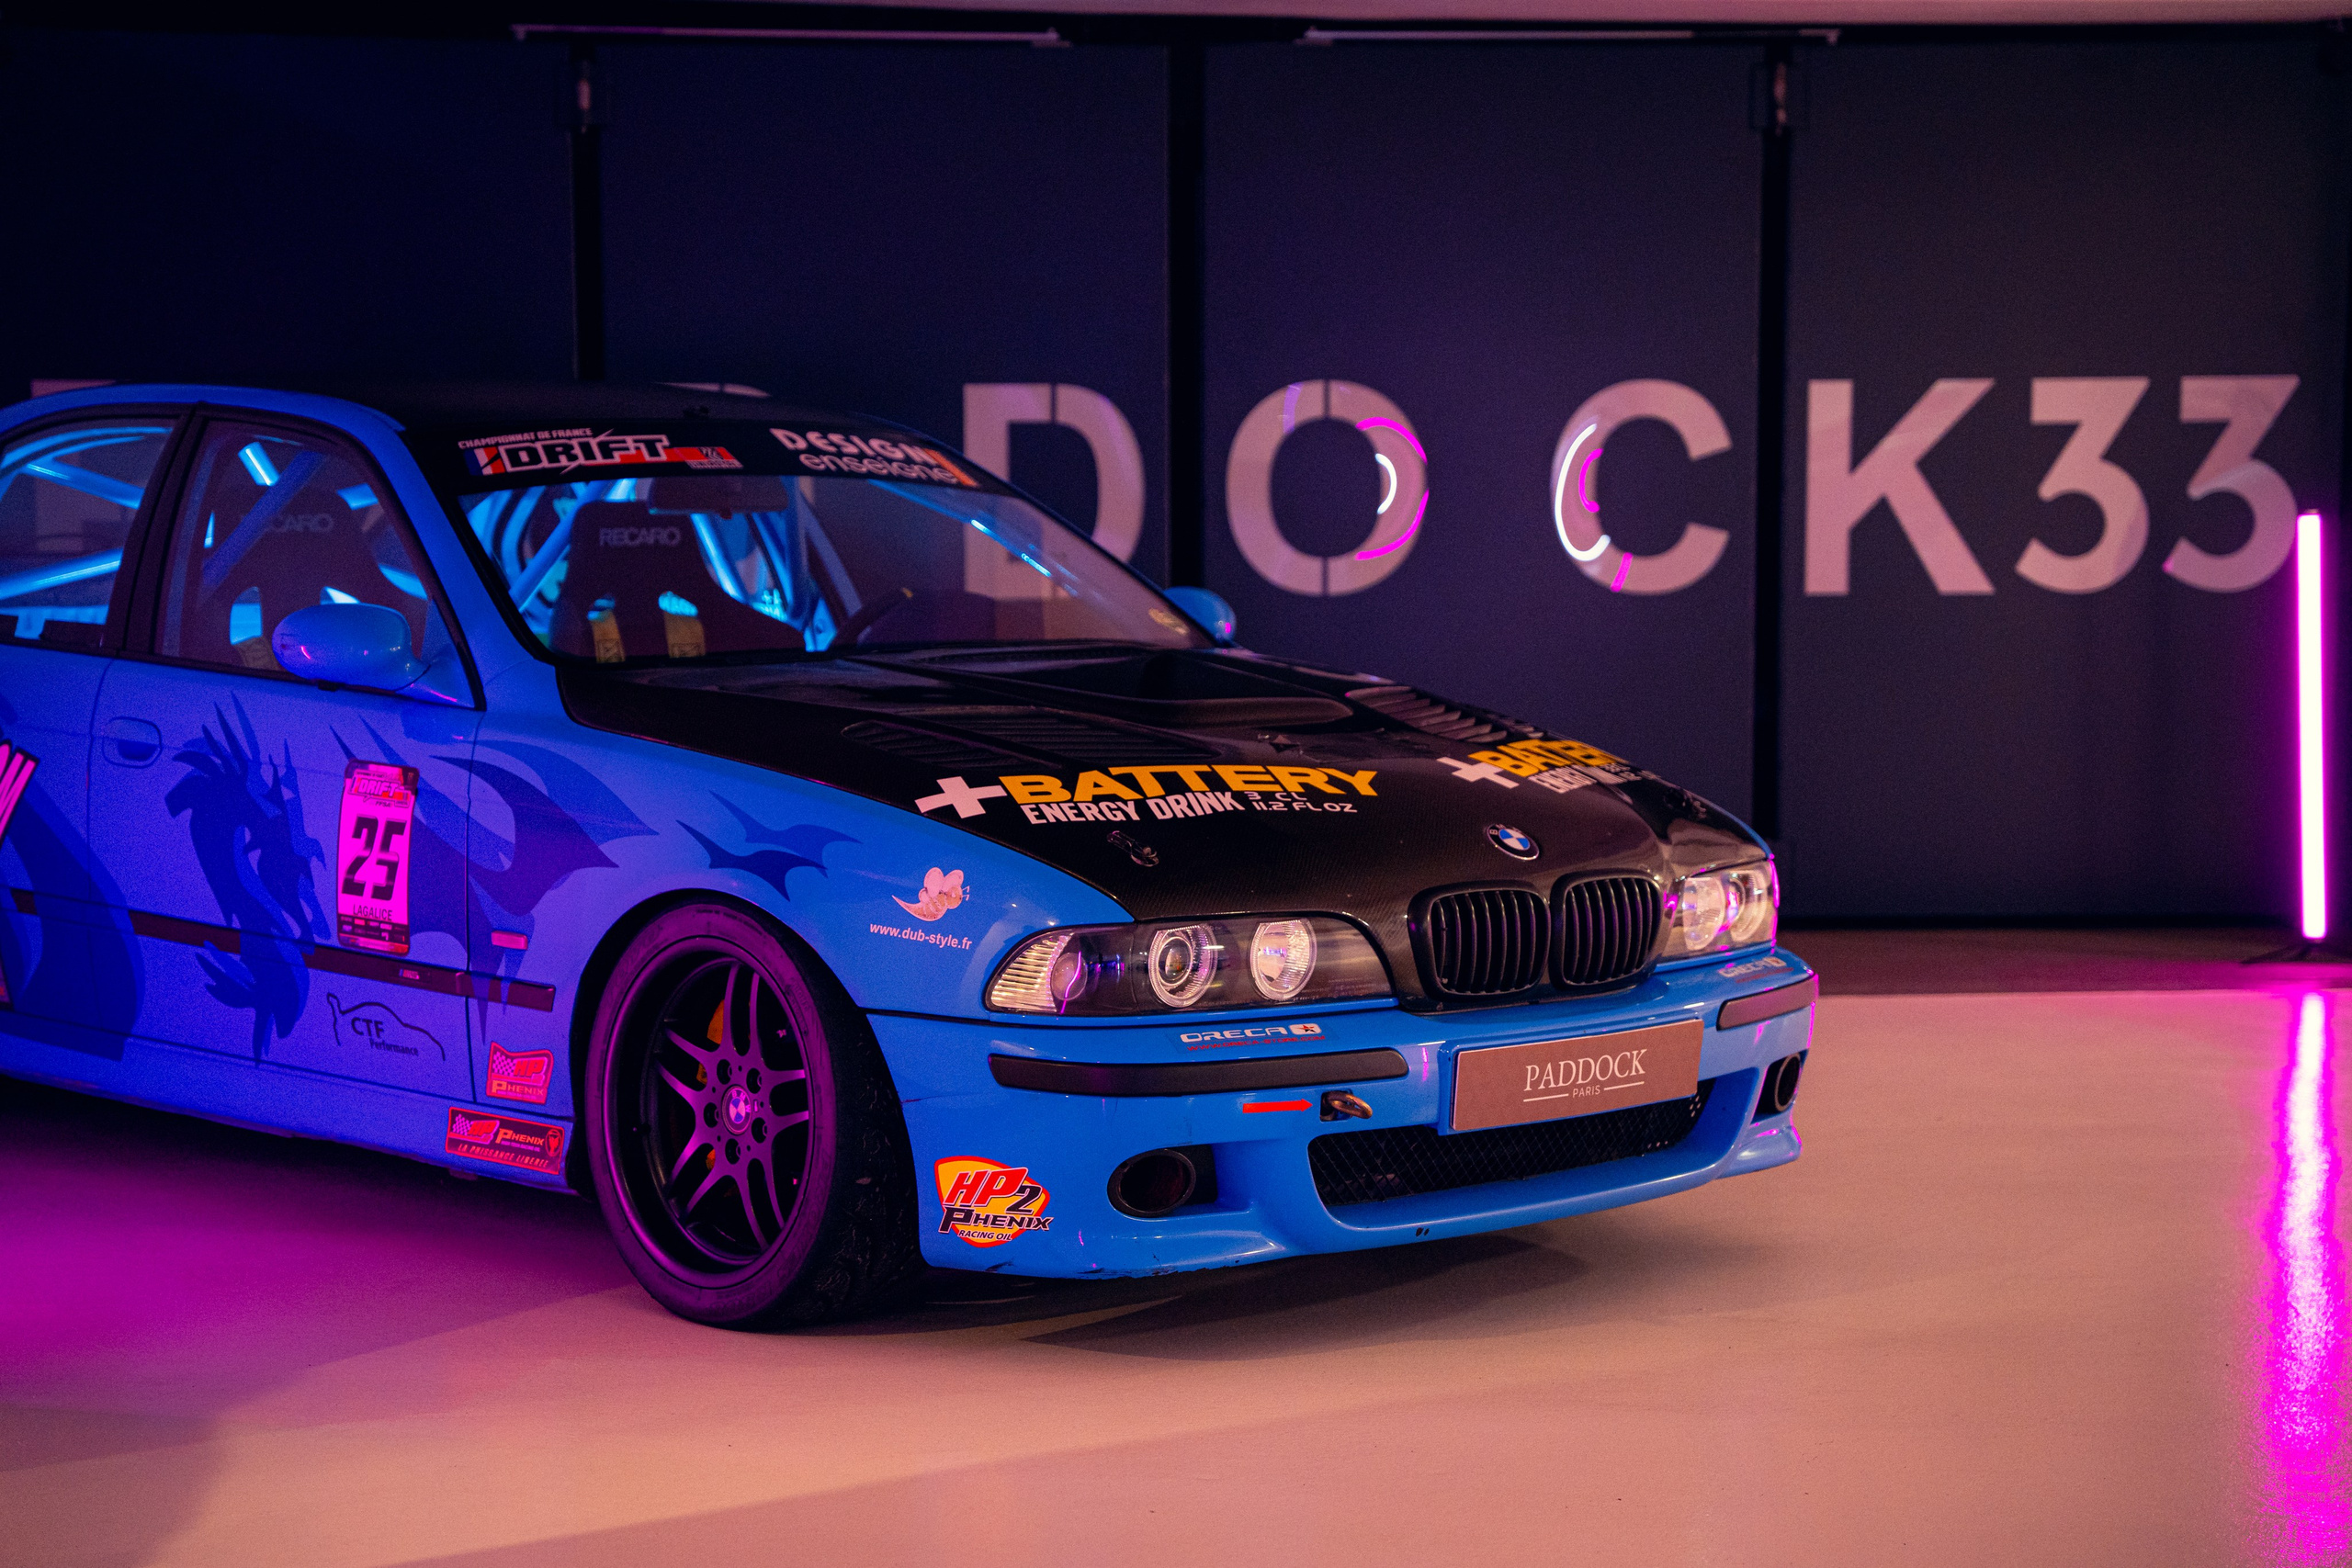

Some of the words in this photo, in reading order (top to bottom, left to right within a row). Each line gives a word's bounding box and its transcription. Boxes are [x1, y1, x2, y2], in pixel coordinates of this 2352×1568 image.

[457, 432, 535, 449] CHAMPIONNAT
[537, 430, 551, 440] DE
[551, 427, 594, 439] FRANCE
[769, 428, 940, 466] DESIGN
[498, 434, 670, 473] DRIFT
[798, 453, 959, 485] enseigne
[599, 525, 682, 547] RECARO
[358, 778, 401, 798] DRIFT
[999, 764, 1379, 804] BATTERY
[1019, 798, 1141, 825] ENERGY
[1146, 791, 1246, 820] DRINK
[1252, 801, 1288, 811] 11.2
[1275, 792, 1307, 802] CL
[341, 813, 408, 901] 25
[353, 903, 393, 922] LAGALICE
[869, 922, 973, 951] www.dub-style.fr
[351, 1016, 385, 1039] CTF
[1180, 1026, 1288, 1043] ORECA
[514, 1058, 546, 1077] HP
[1522, 1048, 1648, 1092] PADDOCK
[492, 1079, 544, 1096] PHENIX
[1572, 1084, 1601, 1100] PARIS
[495, 1128, 545, 1146] PHENIX
[937, 1205, 1055, 1235] PHENIX
[957, 1229, 995, 1241] RACING
[995, 1232, 1013, 1242] OIL
